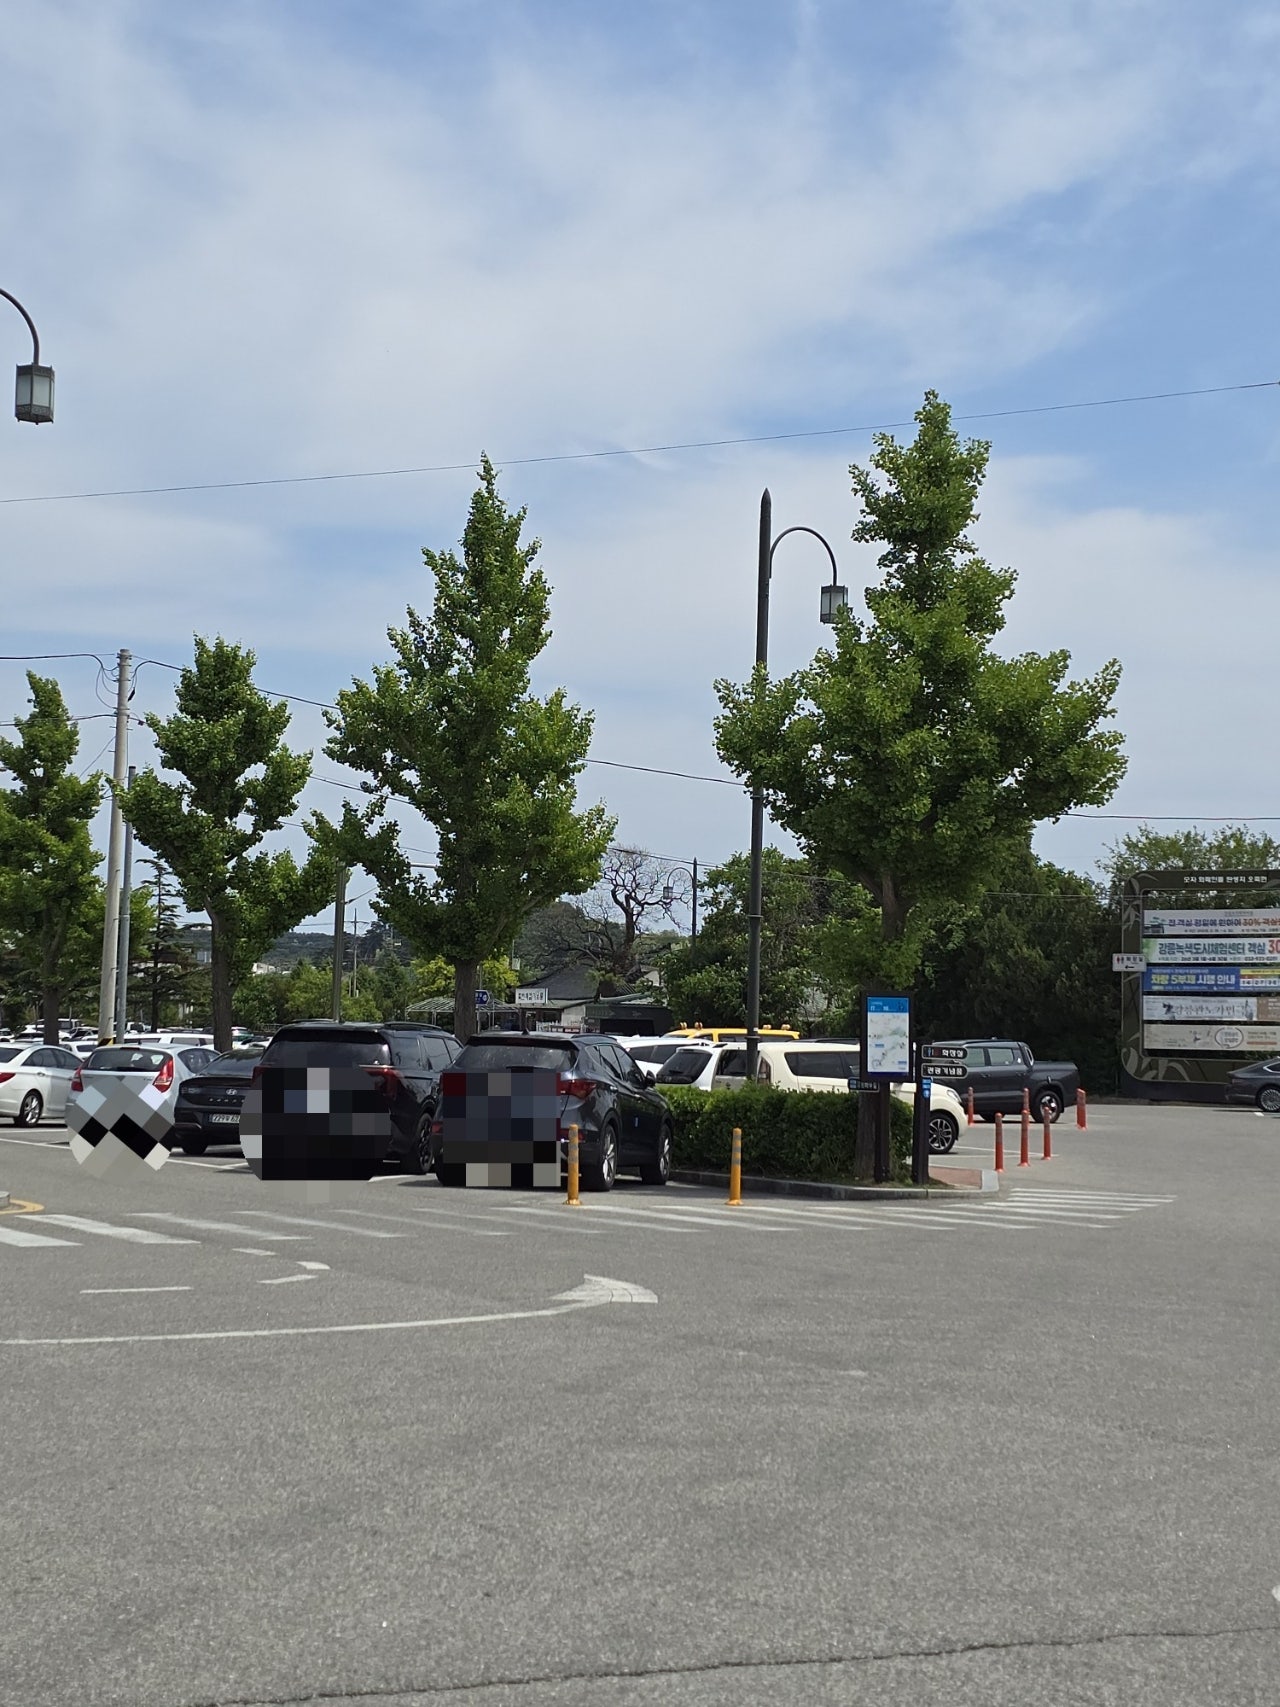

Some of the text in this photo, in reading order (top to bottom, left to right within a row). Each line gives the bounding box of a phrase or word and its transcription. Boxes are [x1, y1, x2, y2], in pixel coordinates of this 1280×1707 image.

[1159, 943, 1245, 955] 강릉녹색도시체험센터
[1248, 943, 1266, 955] 객실
[1151, 974, 1235, 984] 차량 5부제 시행 안내
[942, 1049, 964, 1058] 화장실
